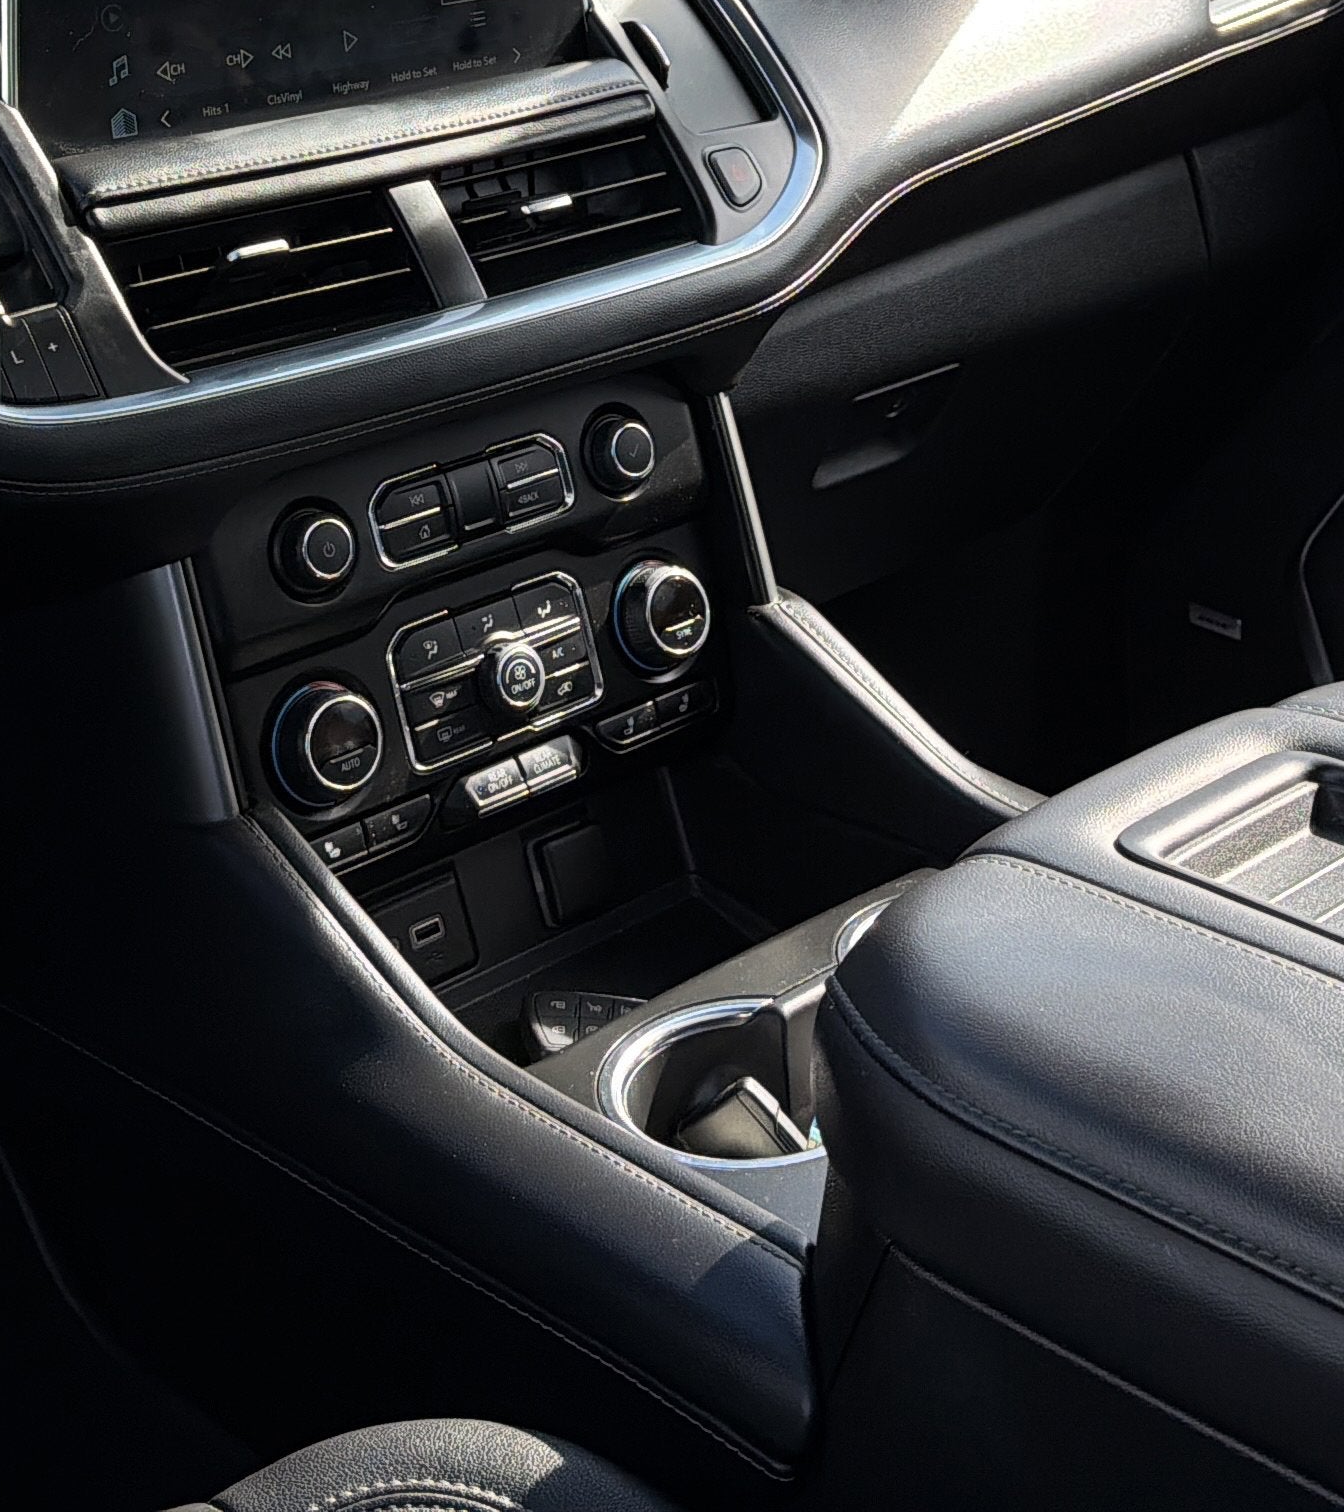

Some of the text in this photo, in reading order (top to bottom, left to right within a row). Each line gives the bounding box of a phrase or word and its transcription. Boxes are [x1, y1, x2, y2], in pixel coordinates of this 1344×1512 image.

[226, 53, 241, 67] CH
[452, 59, 472, 72] Hold
[483, 55, 497, 67] Set
[170, 62, 186, 76] CH
[391, 70, 411, 83] Hold
[423, 66, 438, 78] Set
[332, 80, 370, 95] Highway
[202, 106, 223, 118] Hits
[510, 678, 536, 695] ON/OFF
[341, 756, 361, 772] AUTO
[533, 756, 562, 775] CLIMATE
[487, 775, 514, 794] ON/OFF
